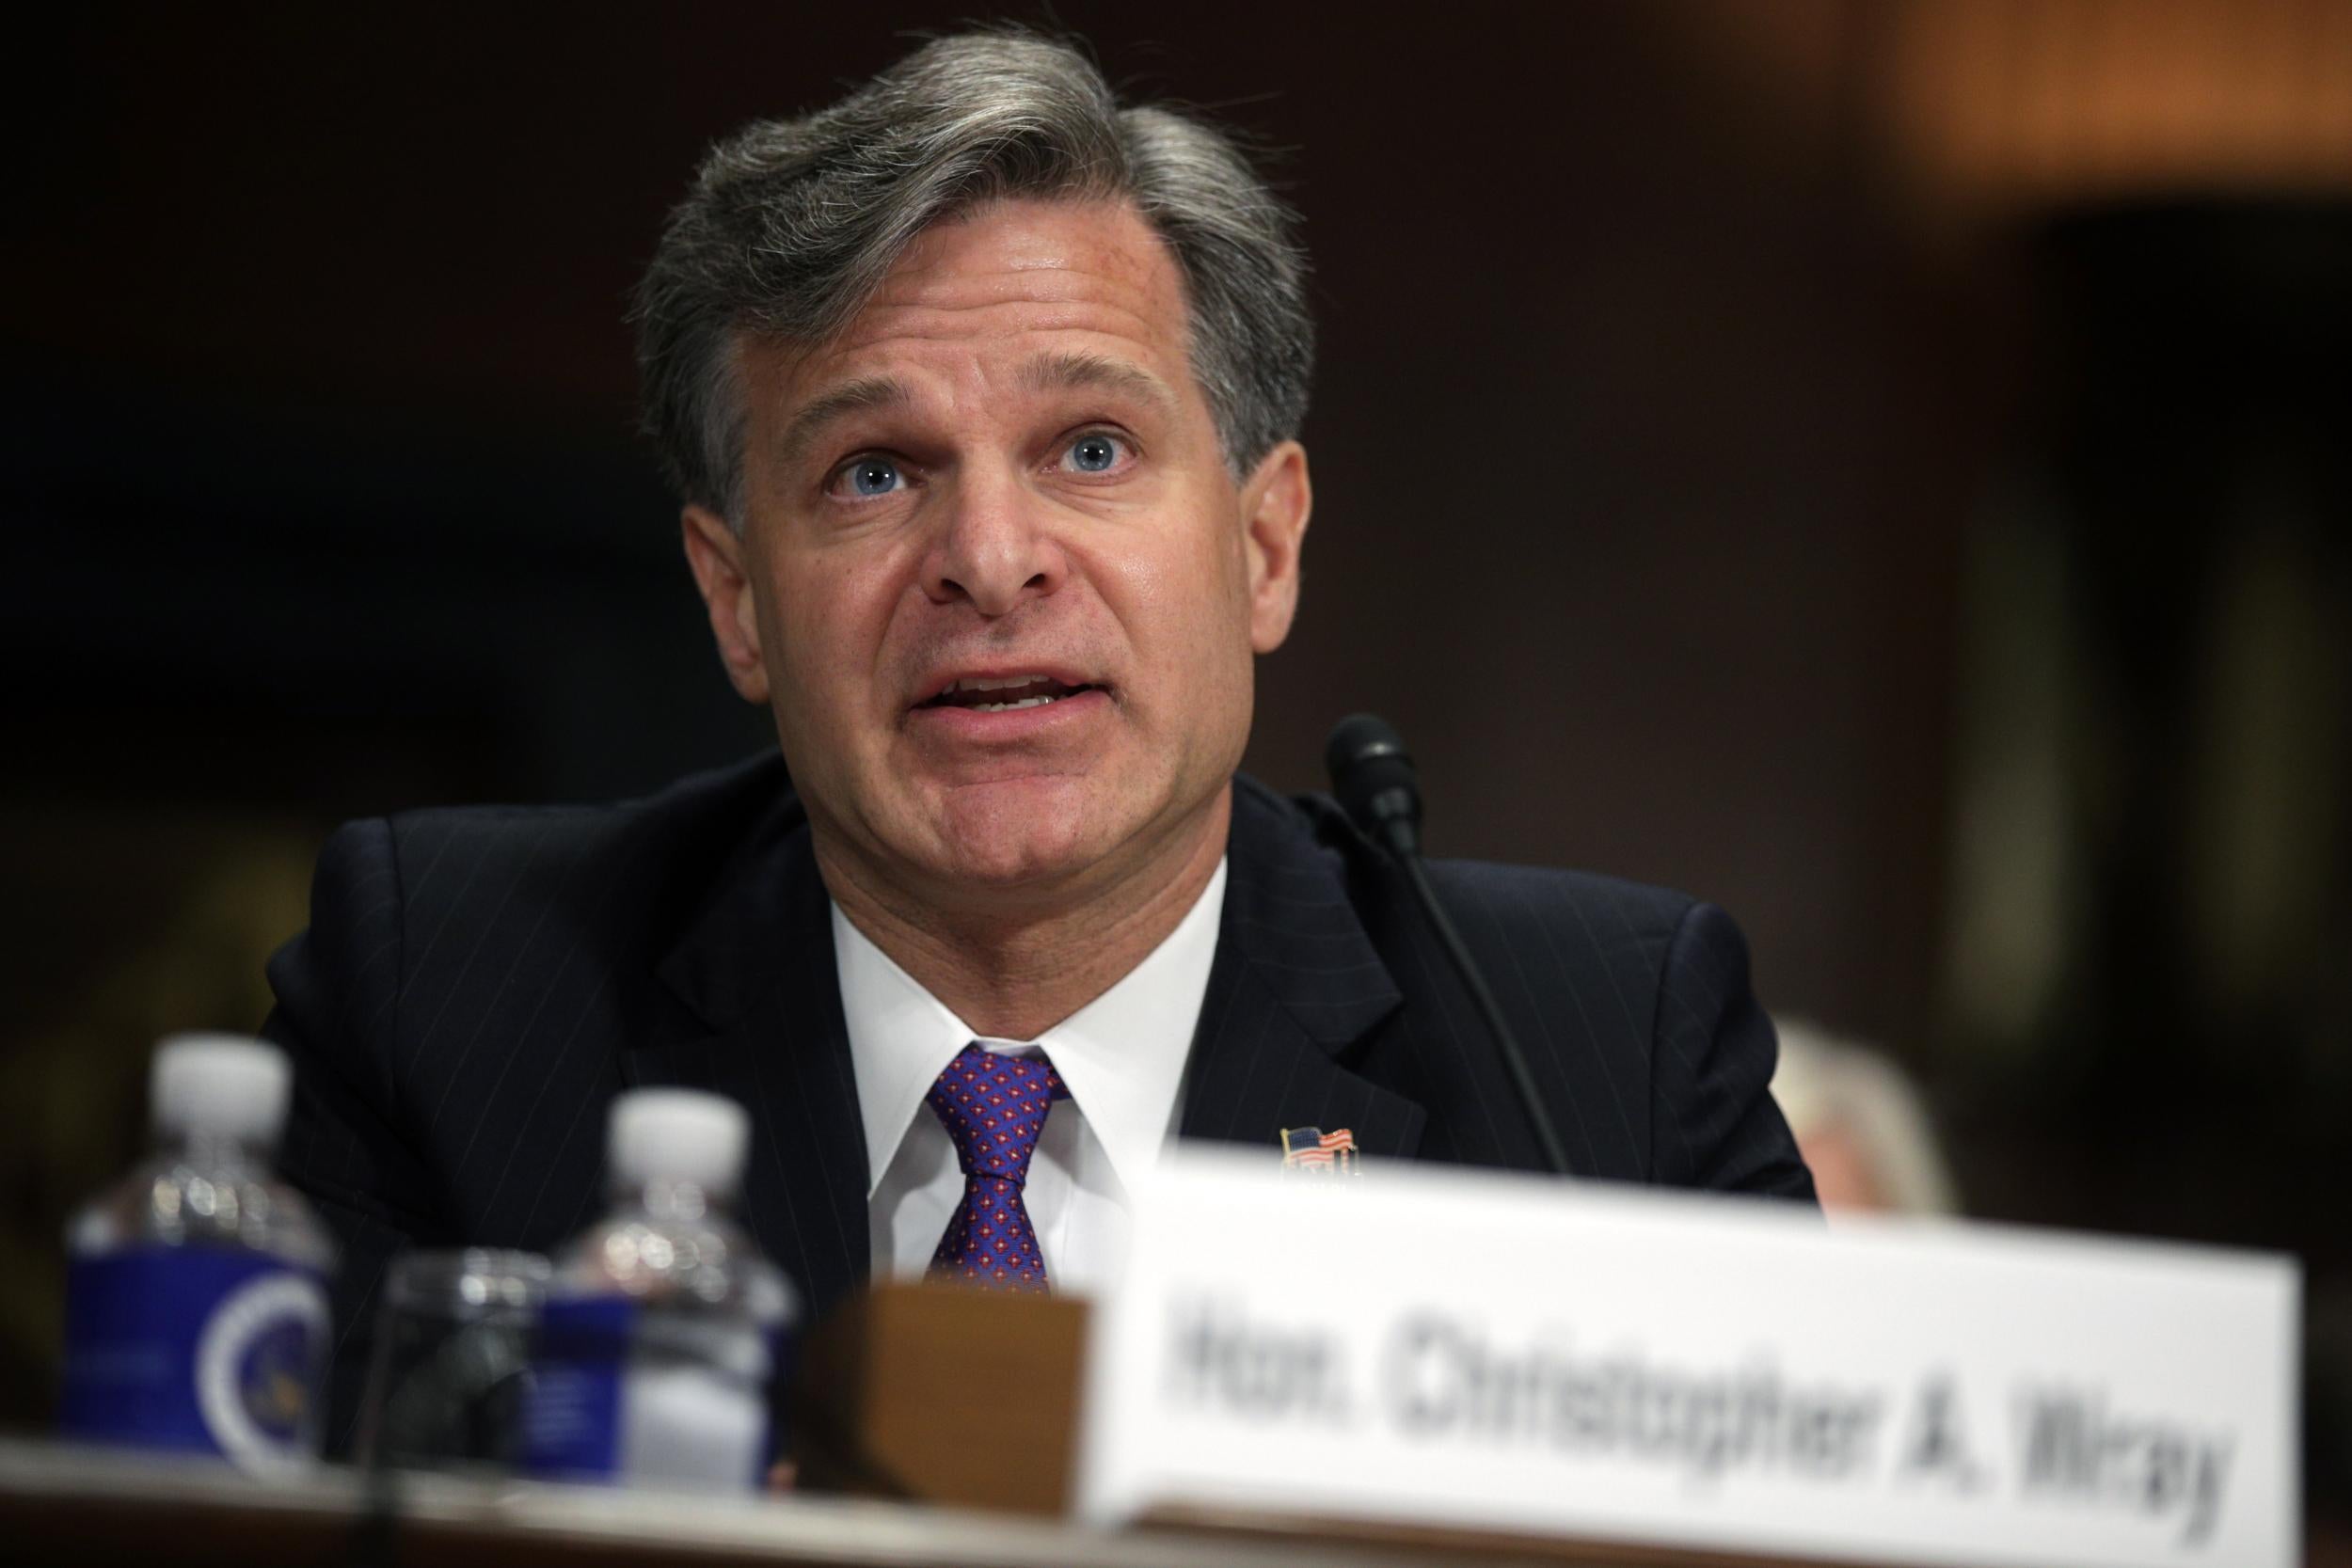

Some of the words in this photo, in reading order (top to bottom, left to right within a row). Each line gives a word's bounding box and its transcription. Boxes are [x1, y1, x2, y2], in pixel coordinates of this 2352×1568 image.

[1168, 1291, 1357, 1426] Hon.
[1387, 1313, 1884, 1490] Christopher
[1900, 1369, 1994, 1496] A.
[2015, 1379, 2237, 1546] Wray
